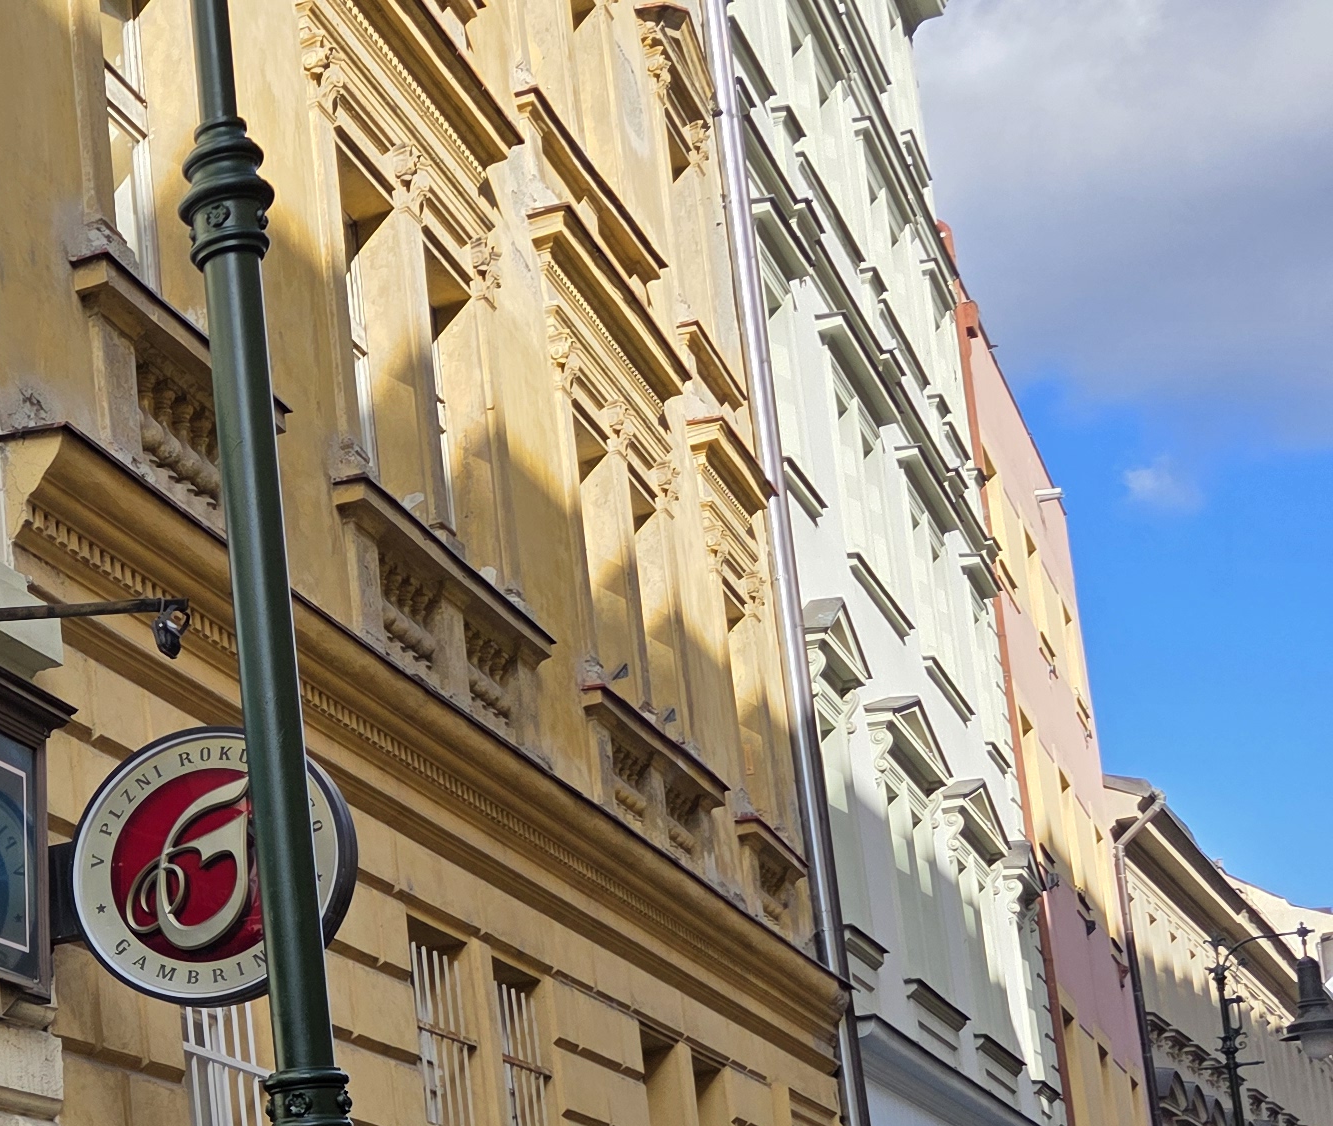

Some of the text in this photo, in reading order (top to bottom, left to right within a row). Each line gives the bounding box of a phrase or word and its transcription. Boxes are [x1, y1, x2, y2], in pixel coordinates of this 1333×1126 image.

[90, 853, 105, 869] V
[99, 764, 163, 837] PLZNI
[115, 938, 267, 984] GAMBRIN
